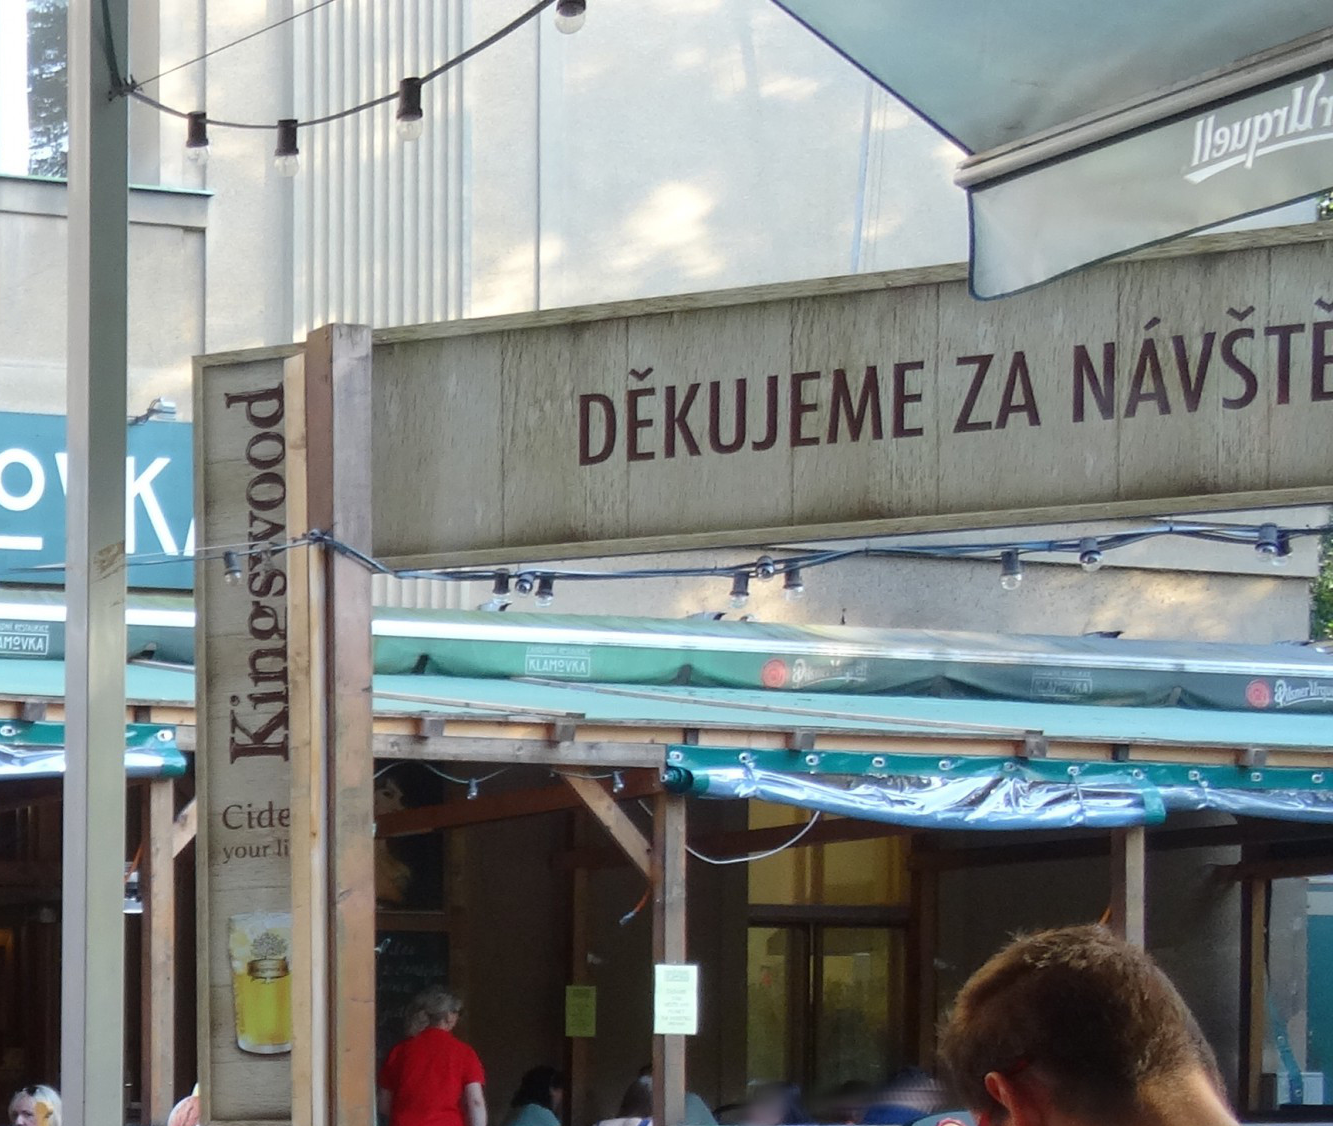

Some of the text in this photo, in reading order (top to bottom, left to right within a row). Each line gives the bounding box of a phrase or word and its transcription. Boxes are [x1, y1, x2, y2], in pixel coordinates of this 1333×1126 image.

[579, 360, 925, 467] DĚKUJEME
[953, 351, 1041, 434] ZA
[224, 383, 290, 764] Kingswood
[223, 842, 269, 864] your
